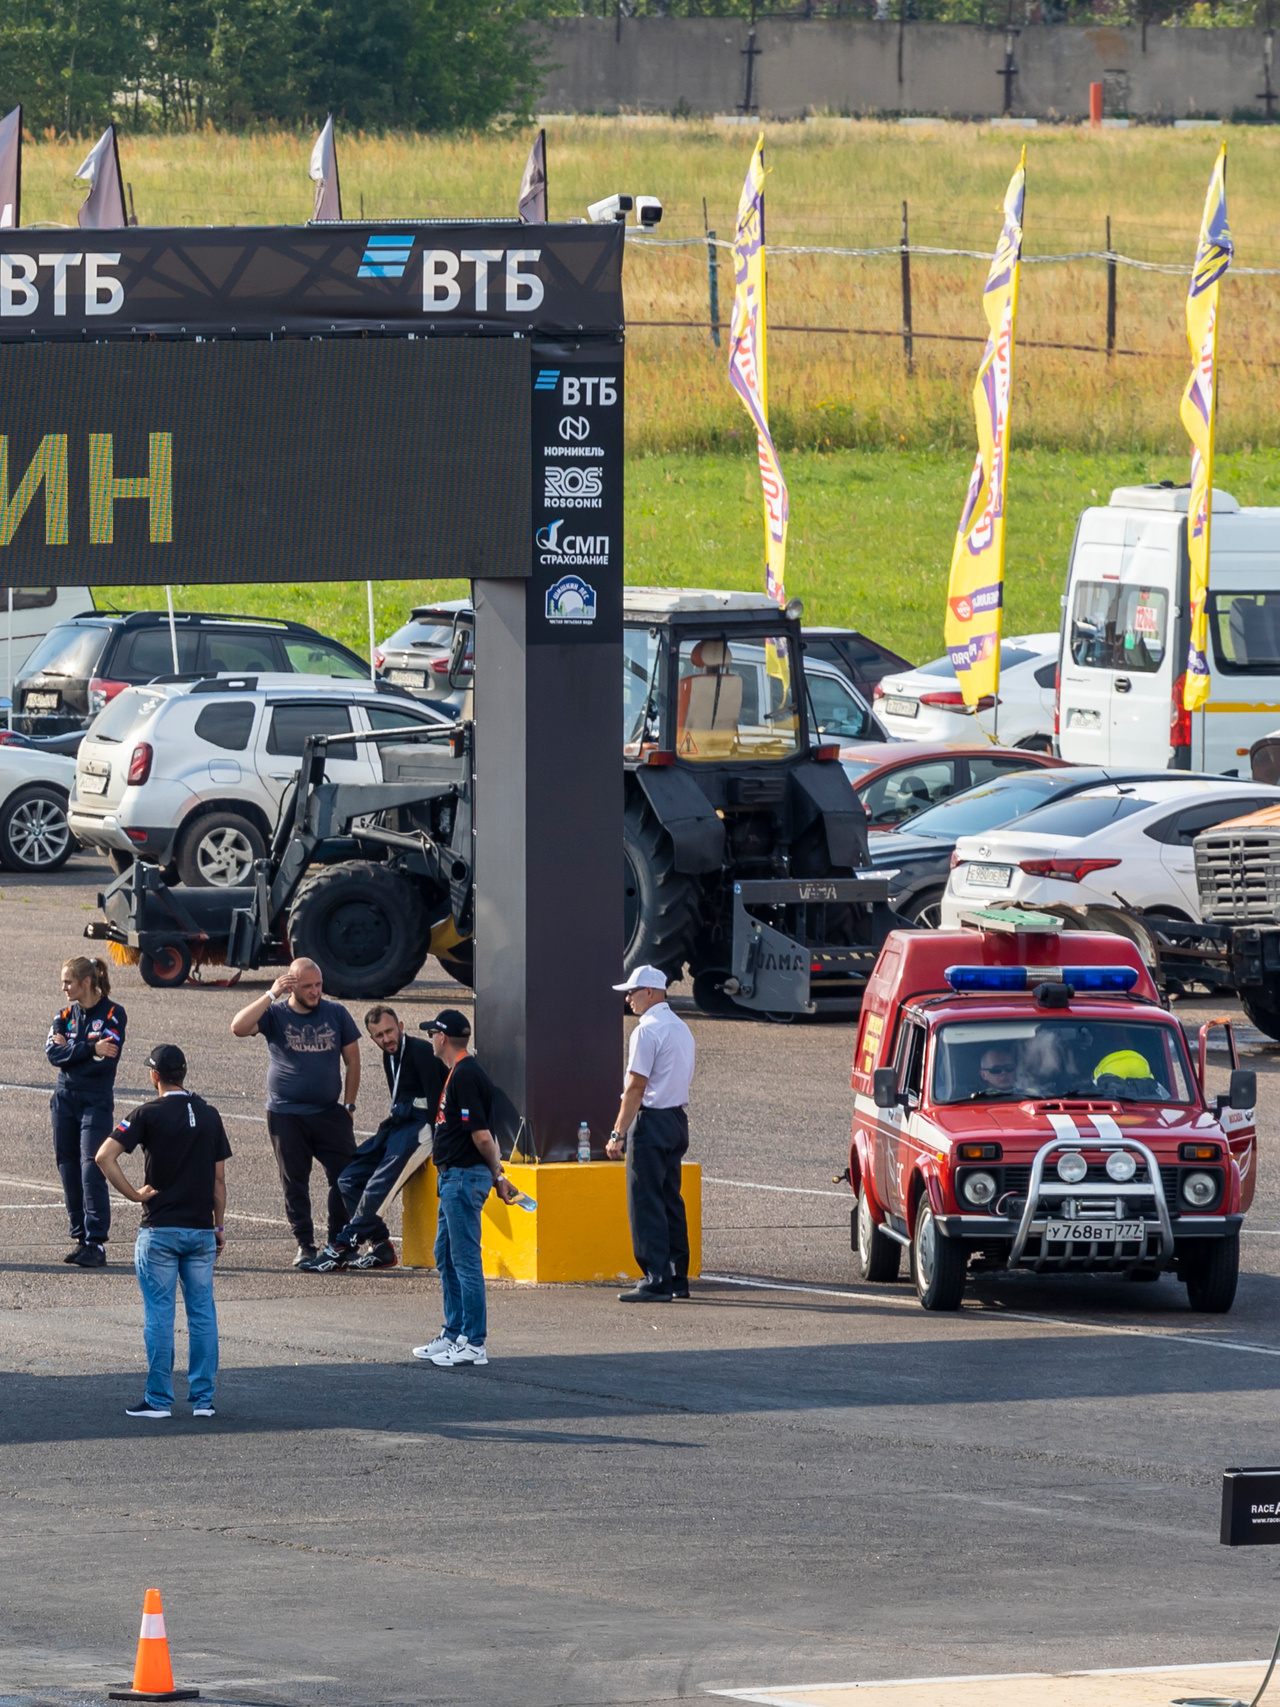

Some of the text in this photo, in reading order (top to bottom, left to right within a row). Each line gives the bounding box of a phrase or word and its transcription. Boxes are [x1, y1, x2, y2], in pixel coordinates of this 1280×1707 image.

[0, 252, 125, 317] ВТБ
[422, 249, 545, 312] ВТБ
[563, 376, 617, 405] ВТБ
[544, 446, 605, 457] НОРНИКЕЛЬ
[544, 498, 603, 508] ROSGONKI
[563, 535, 610, 554] СМП
[540, 554, 609, 565] СТРАХОВАНИЕ
[1052, 1224, 1140, 1240] У768ВТ 777
